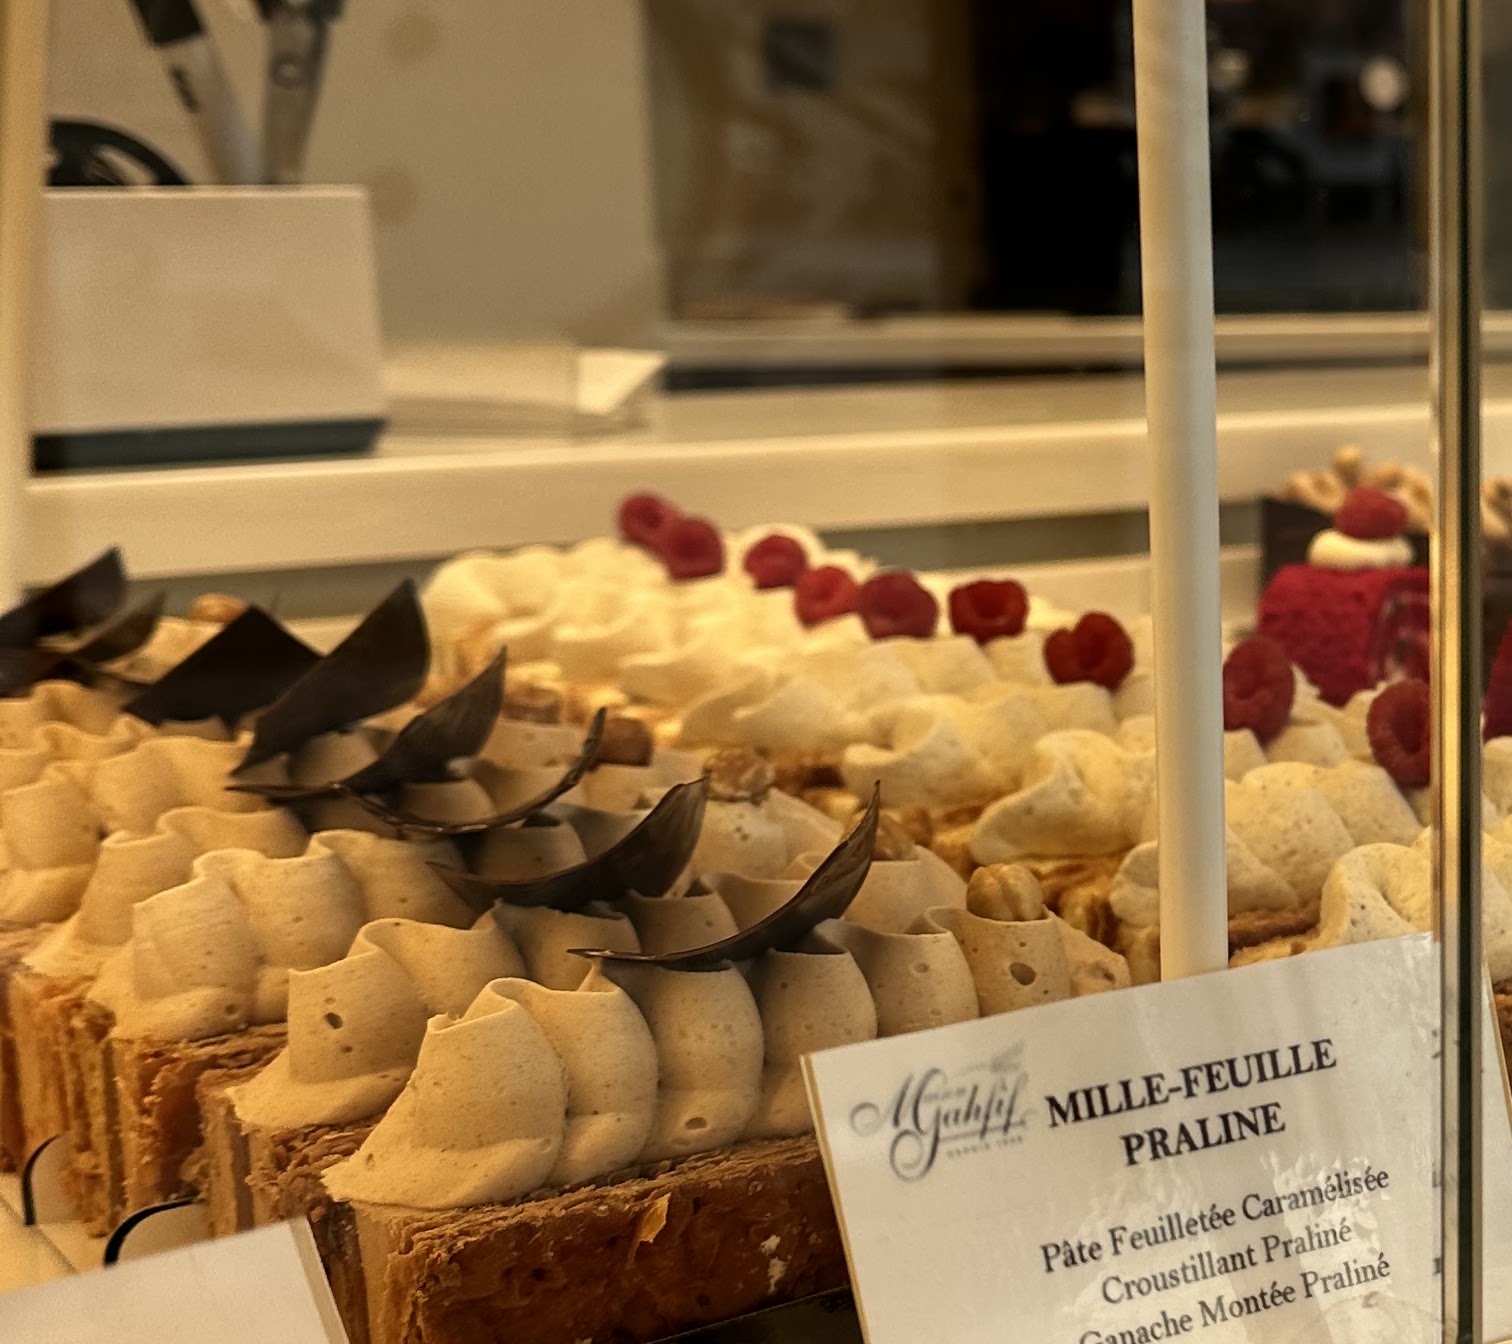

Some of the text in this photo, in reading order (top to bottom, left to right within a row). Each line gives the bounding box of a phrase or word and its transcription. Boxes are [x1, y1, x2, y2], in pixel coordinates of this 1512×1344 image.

[1044, 1038, 1338, 1129] MILLE-FEUILLE
[1119, 1101, 1287, 1167] PRALINE
[1039, 1165, 1390, 1274] Pâte Feuilletée Caramélisée
[1101, 1217, 1353, 1305] Croustillant Praliné
[1197, 1281, 1297, 1329] Montée
[1299, 1251, 1391, 1299] Praliné
